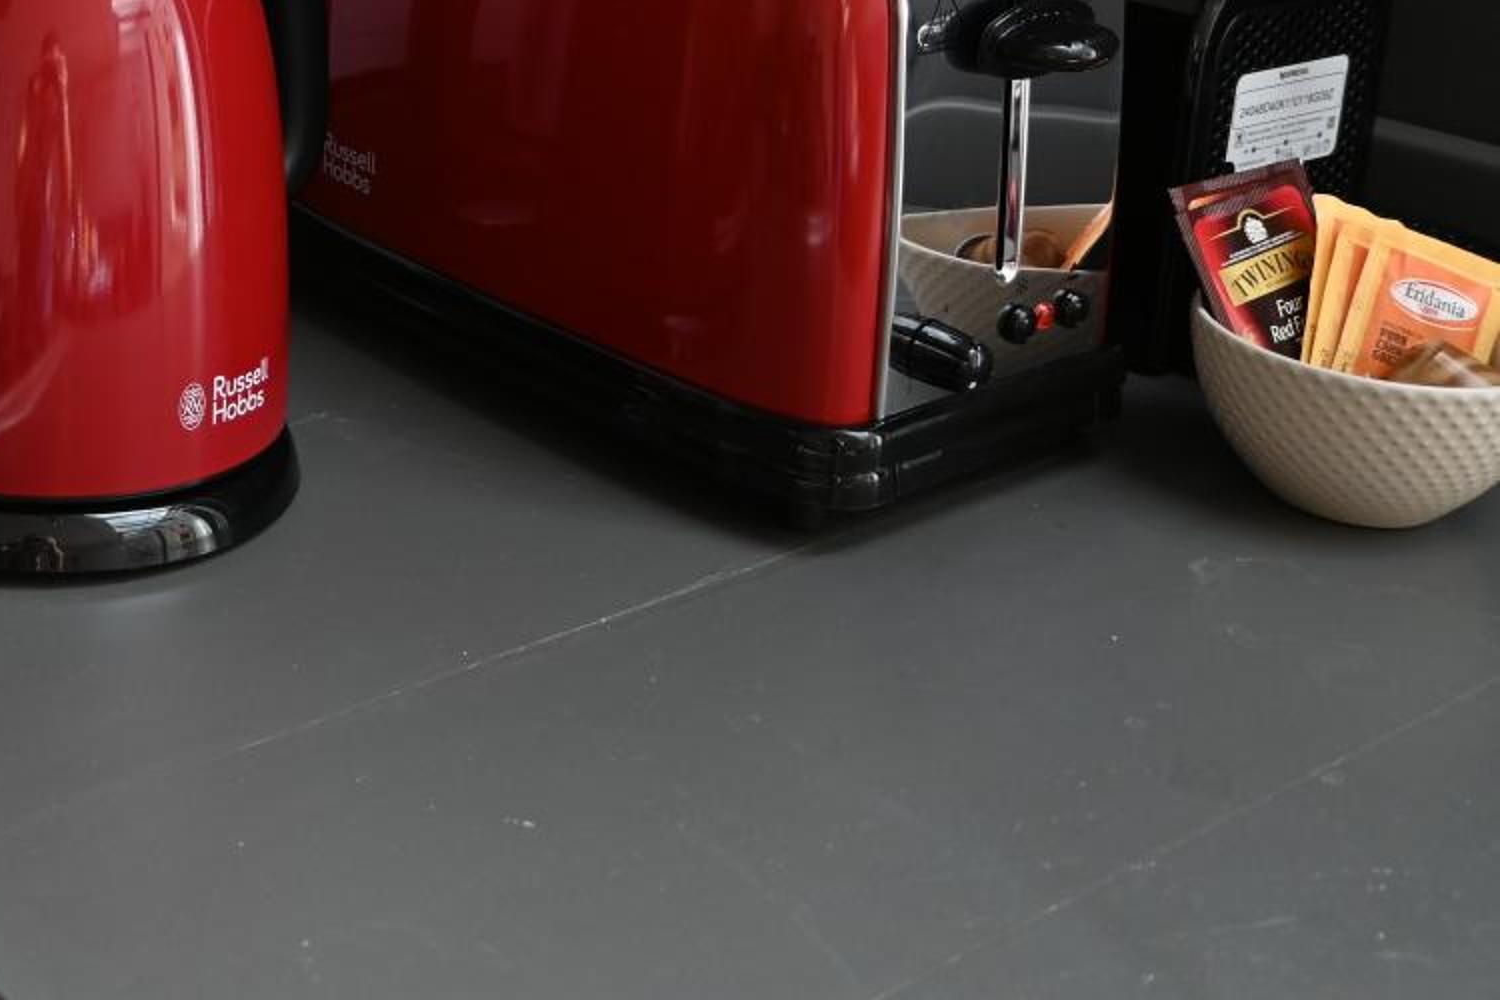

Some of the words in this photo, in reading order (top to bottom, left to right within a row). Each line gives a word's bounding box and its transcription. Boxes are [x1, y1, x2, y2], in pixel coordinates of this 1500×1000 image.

[1231, 249, 1310, 297] TWININ
[1404, 280, 1467, 319] Eridania
[1270, 318, 1296, 344] Red
[213, 356, 269, 401] Russell
[212, 389, 266, 425] Hobbs
